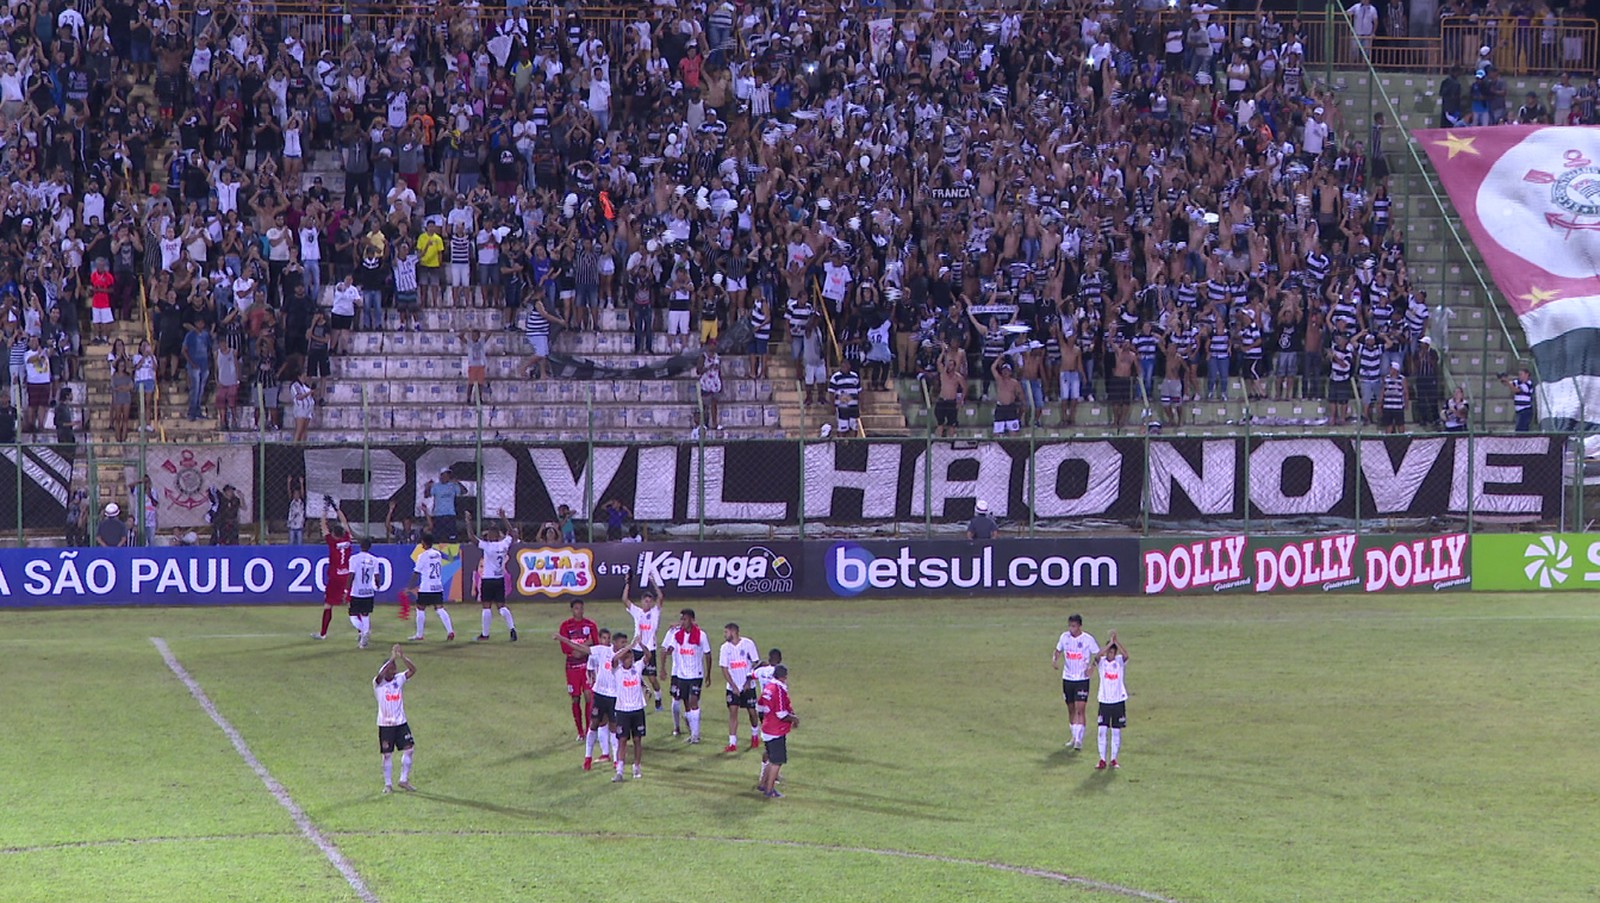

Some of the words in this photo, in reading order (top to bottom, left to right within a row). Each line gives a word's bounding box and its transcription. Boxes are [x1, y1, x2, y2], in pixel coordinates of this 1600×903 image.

[1141, 436, 1550, 515] NOVE
[24, 551, 116, 595] SÃO
[131, 557, 274, 594] PAULO
[429, 562, 441, 579] 20
[524, 556, 570, 570] VOLTA
[525, 570, 588, 588] AULAS
[598, 563, 607, 574] é
[612, 565, 630, 575] na
[836, 546, 1118, 588] betsul.com
[1145, 535, 1245, 594] DOLLY
[1255, 534, 1357, 592] DOLLY
[1365, 534, 1467, 592] DOLLY
[737, 579, 793, 592] .com
